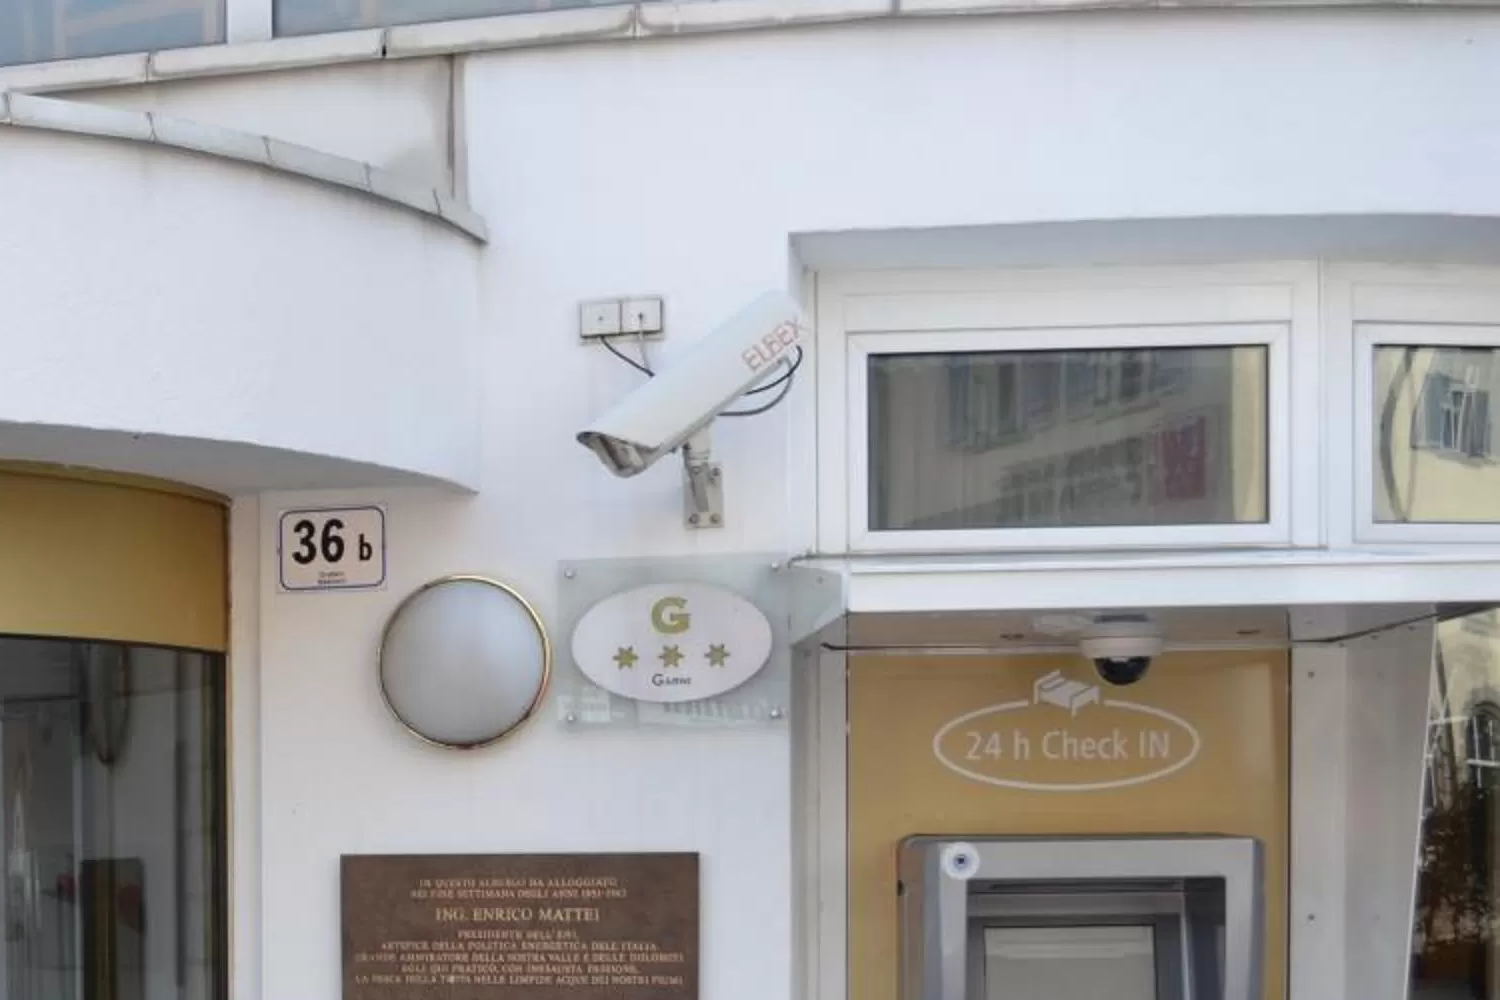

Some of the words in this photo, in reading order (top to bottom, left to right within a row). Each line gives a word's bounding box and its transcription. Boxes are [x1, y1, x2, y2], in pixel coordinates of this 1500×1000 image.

[740, 316, 803, 371] ELBEX
[292, 518, 345, 565] 36
[359, 533, 373, 562] b
[651, 596, 692, 635] G
[965, 731, 1002, 761] 24
[1013, 730, 1030, 761] h
[1042, 728, 1129, 760] Check
[1139, 730, 1170, 759] IN
[473, 907, 533, 921] ENRICO
[539, 907, 599, 922] MATTEI
